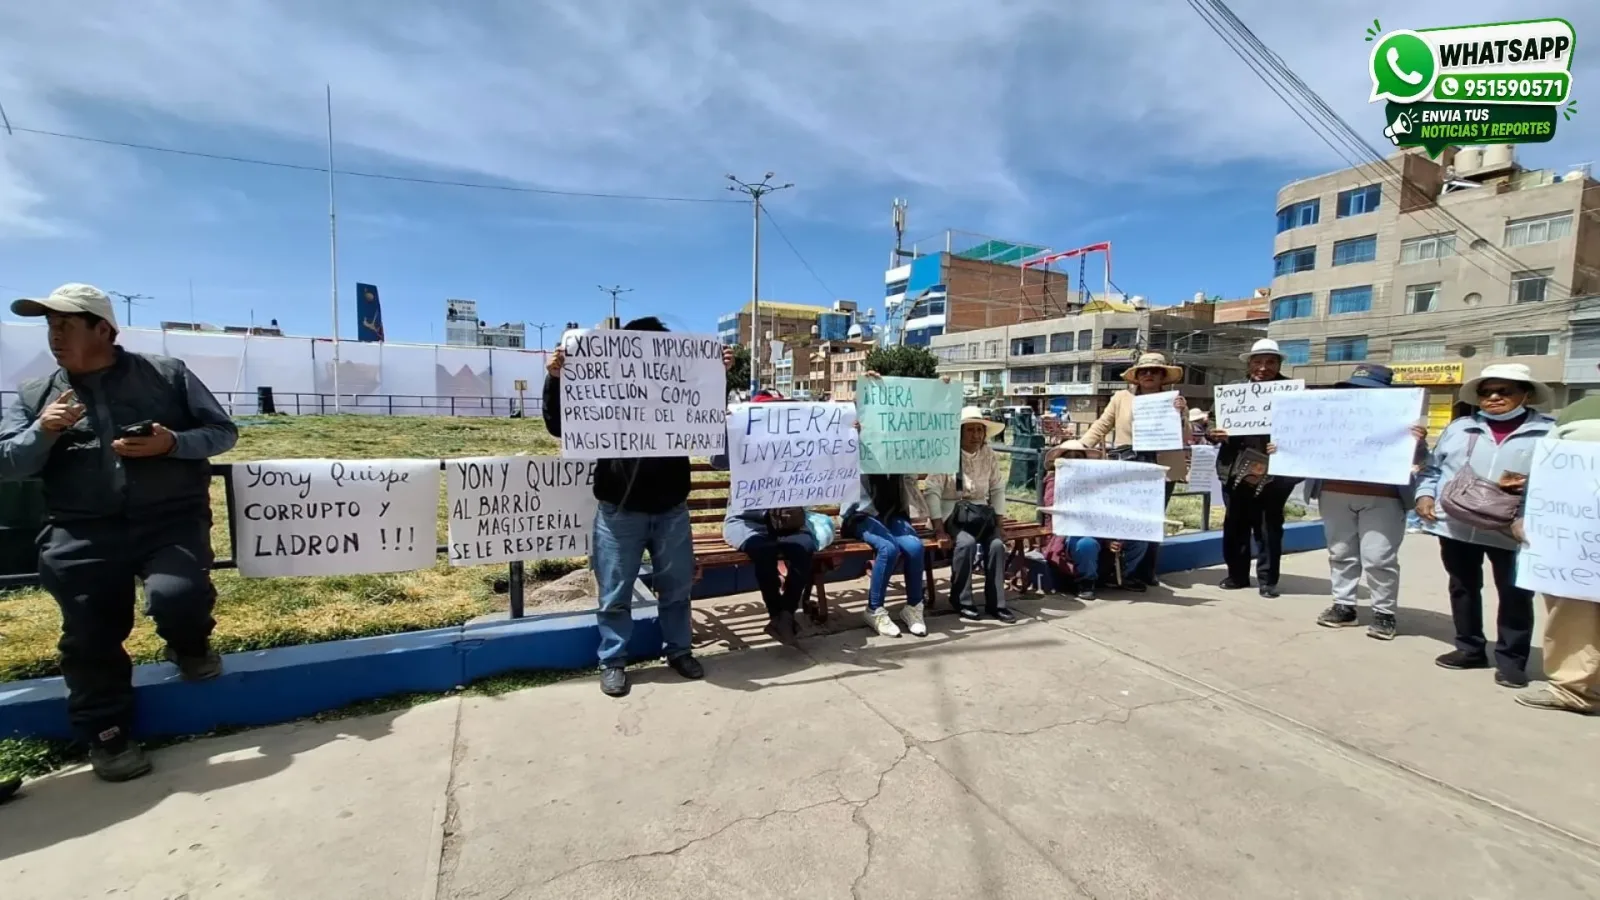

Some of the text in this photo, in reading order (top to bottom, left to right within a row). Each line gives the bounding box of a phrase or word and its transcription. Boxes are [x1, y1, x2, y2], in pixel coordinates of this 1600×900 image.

[564, 335, 643, 359] EXIGIMOS
[562, 362, 686, 383] SOBRE LA ILEGAL
[661, 386, 700, 407] COMO
[564, 405, 726, 424] PRESIDENTE DEL BARRIO
[746, 406, 841, 435] FUERA
[1220, 403, 1257, 415] Fuera
[878, 412, 961, 431] TRAFICANTES
[1222, 417, 1272, 429] Barri
[564, 432, 725, 451] MAGISTERIAL TAPARACHI
[741, 438, 857, 465] INVASORES
[860, 442, 873, 460] DE
[457, 458, 597, 492] YONY QUISPE
[780, 459, 812, 473] DEL
[247, 462, 411, 499] Yony Quispe
[736, 468, 859, 499] BARRIO MAGISTERIAL
[453, 491, 541, 520] AL BARRIO
[741, 484, 847, 508] DE TAPARACHI
[1528, 488, 1600, 520] Samuel
[244, 501, 360, 521] CORRUPTO
[477, 510, 581, 536] MAGISTERIAL
[254, 533, 359, 557] LADRON
